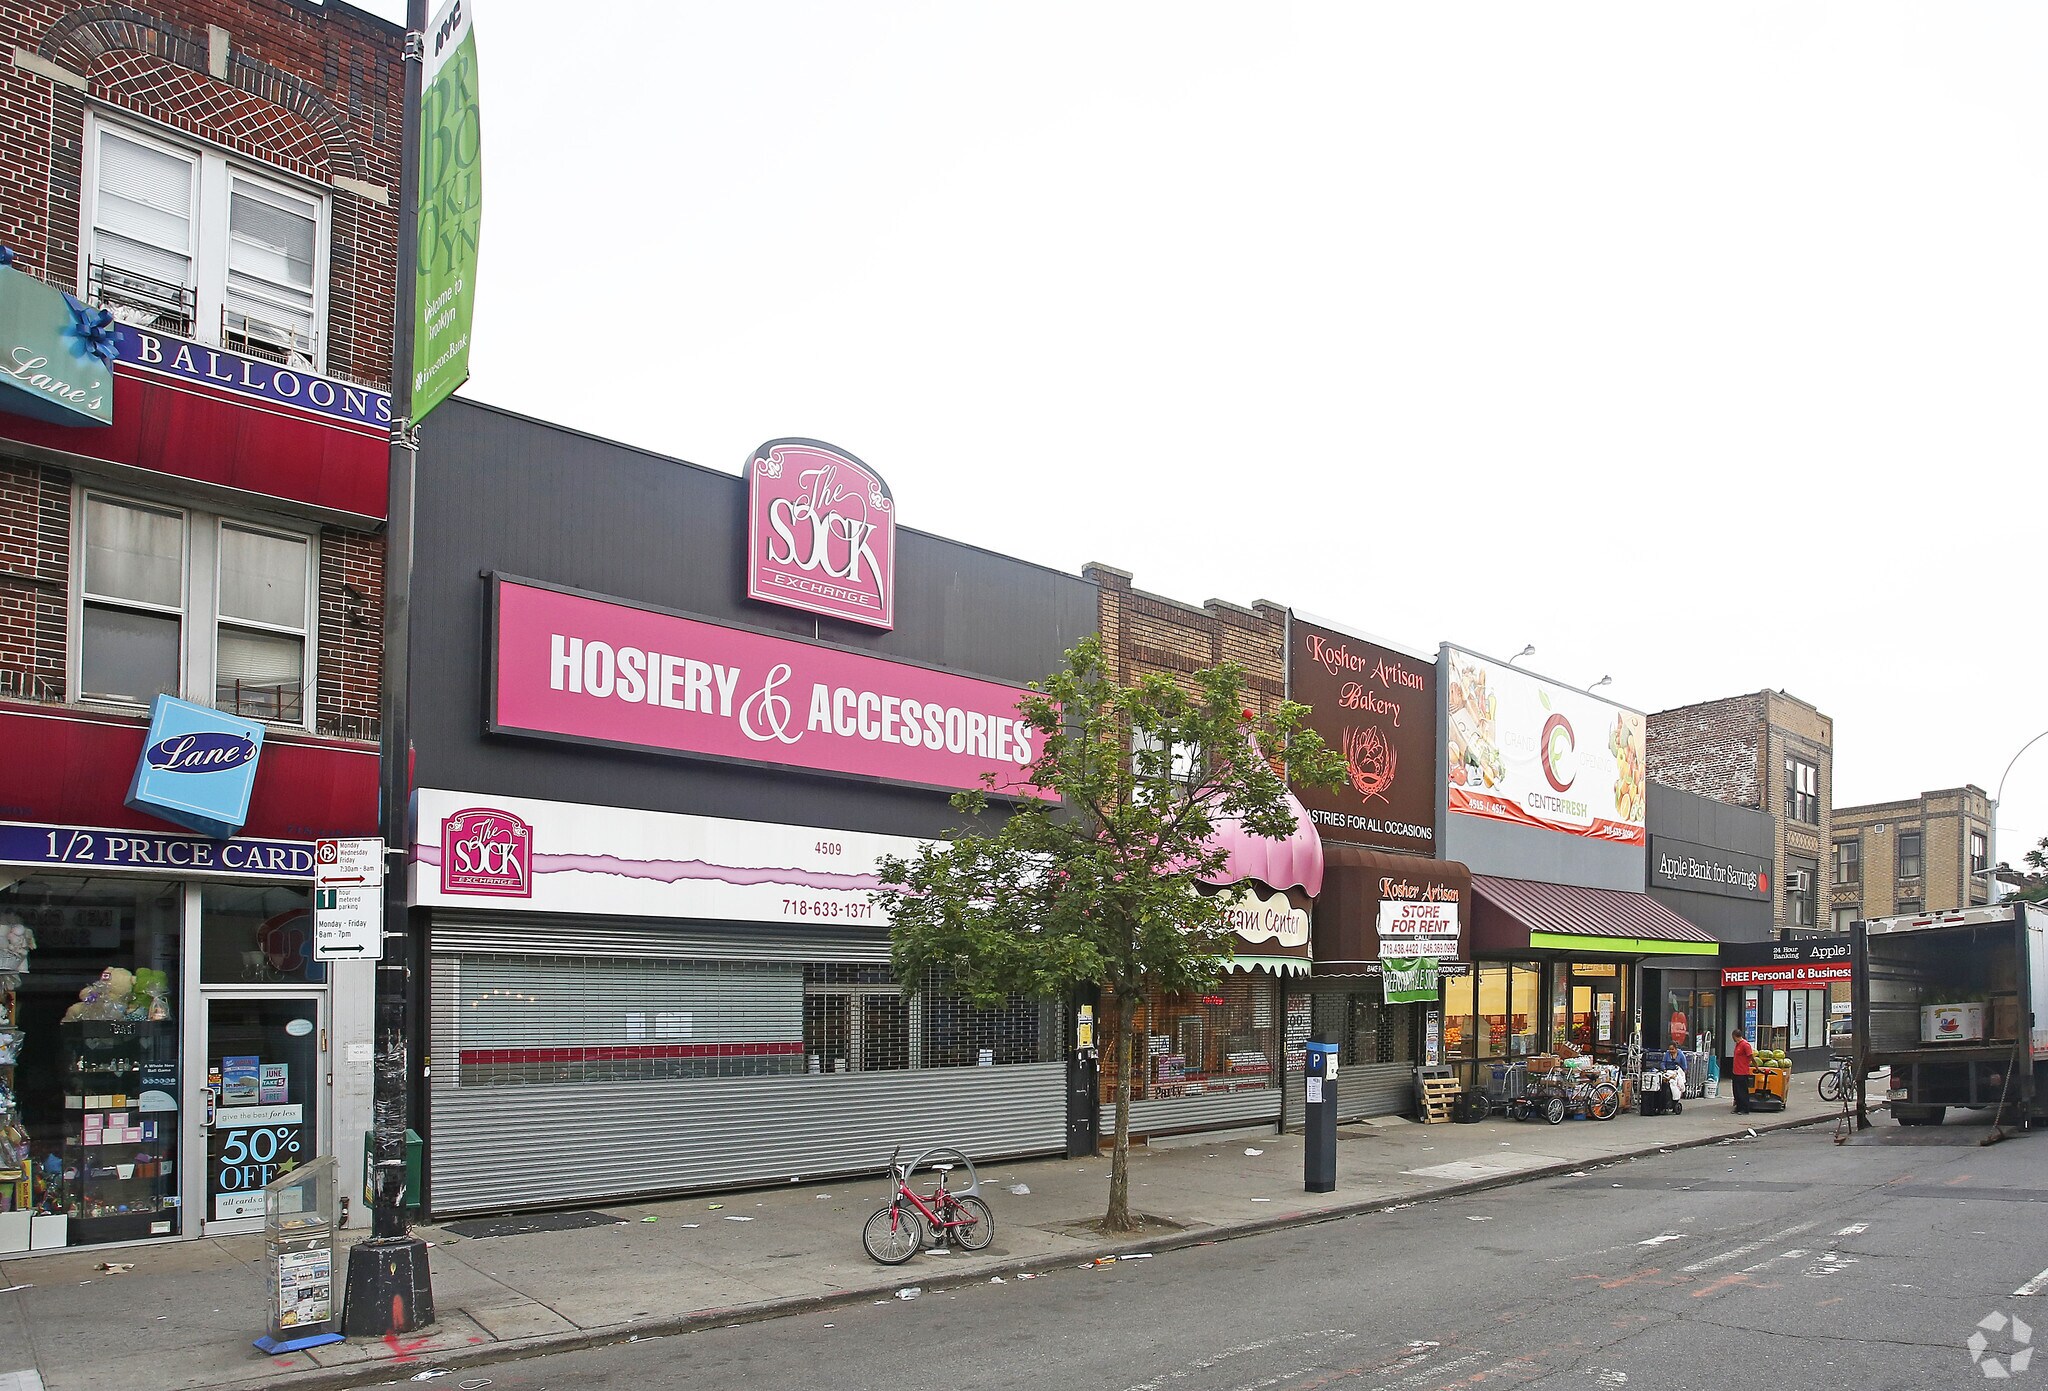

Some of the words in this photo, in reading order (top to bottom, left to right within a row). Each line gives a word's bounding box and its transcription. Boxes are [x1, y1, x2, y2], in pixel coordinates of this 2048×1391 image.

[454, 276, 463, 295] to
[0, 346, 103, 410] Lane's
[137, 333, 391, 422] BALLOONS
[767, 498, 884, 609] SOCK
[774, 573, 870, 604] EXCHANGE
[1306, 634, 1366, 676] Kosher
[1370, 657, 1423, 691] Artisan
[550, 633, 741, 718] HOSIERY
[738, 663, 804, 745] &
[807, 682, 1033, 765] ACCESSORIES
[1339, 681, 1400, 727] Bakery
[151, 731, 257, 771] Lane's
[1504, 730, 1536, 752] GRAND
[1527, 792, 1588, 818] CENTERFRESH
[1306, 808, 1346, 828] ASTRIES
[1347, 814, 1367, 831] FOR
[1366, 819, 1383, 833] ALL
[1384, 820, 1433, 840] OCCASIONS
[45, 830, 95, 861] 1/2
[104, 837, 214, 867] PRICE
[221, 845, 317, 872] CARD
[339, 849, 368, 857] Wednesday
[815, 841, 842, 856] 4509
[339, 857, 355, 865] Friday
[454, 840, 524, 887] SOCK
[1659, 852, 1688, 880] Apple
[1688, 857, 1712, 881] Bank
[1713, 862, 1726, 882] for
[1727, 864, 1758, 891] Savings
[459, 876, 514, 886] EXCHANGE
[1379, 877, 1419, 901] Kosher
[1421, 881, 1460, 902] Artisan
[322, 889, 330, 908] 1
[338, 902, 359, 910] parking
[782, 899, 872, 919] 718-633-1371
[1264, 908, 1300, 935] Center
[1401, 905, 1440, 919] STORE
[318, 920, 342, 929] Monday
[348, 919, 367, 928] Friday
[318, 930, 333, 938] 8am
[338, 930, 352, 939] 7pm
[1391, 919, 1416, 933] FOR
[1418, 920, 1450, 933] RENT
[1773, 952, 1800, 960] Banking
[1809, 944, 1846, 960] Apple
[1725, 971, 1749, 982] FREE
[1751, 968, 1794, 981] Personal
[1796, 969, 1806, 979] &
[1807, 966, 1852, 978] Business
[1313, 1053, 1320, 1067] P
[269, 1110, 281, 1119] for
[220, 1127, 300, 1165] 50%
[220, 1163, 277, 1190] OFF
[222, 1198, 234, 1206] all
[235, 1196, 256, 1204] cards
